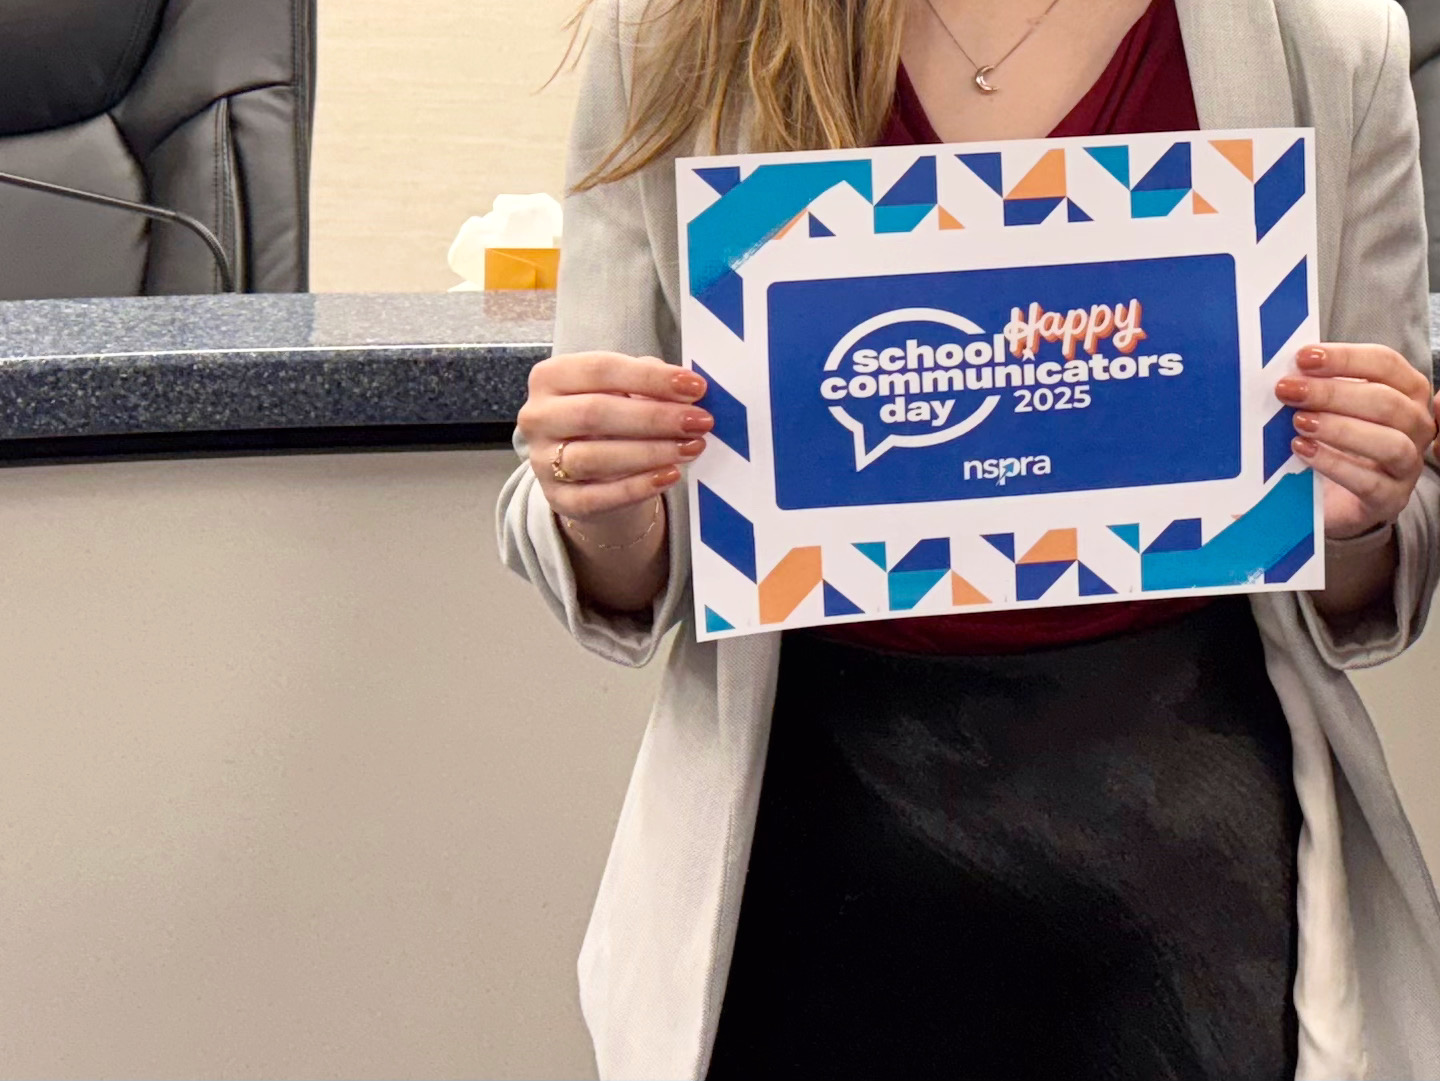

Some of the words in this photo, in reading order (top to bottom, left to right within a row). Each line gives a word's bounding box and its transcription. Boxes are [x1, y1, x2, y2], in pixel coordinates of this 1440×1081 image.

[1002, 297, 1147, 361] Happy
[852, 333, 1007, 374] school
[819, 349, 1184, 401] communicators
[879, 395, 956, 427] day
[1012, 384, 1092, 414] 2025
[962, 453, 1052, 486] nspra
